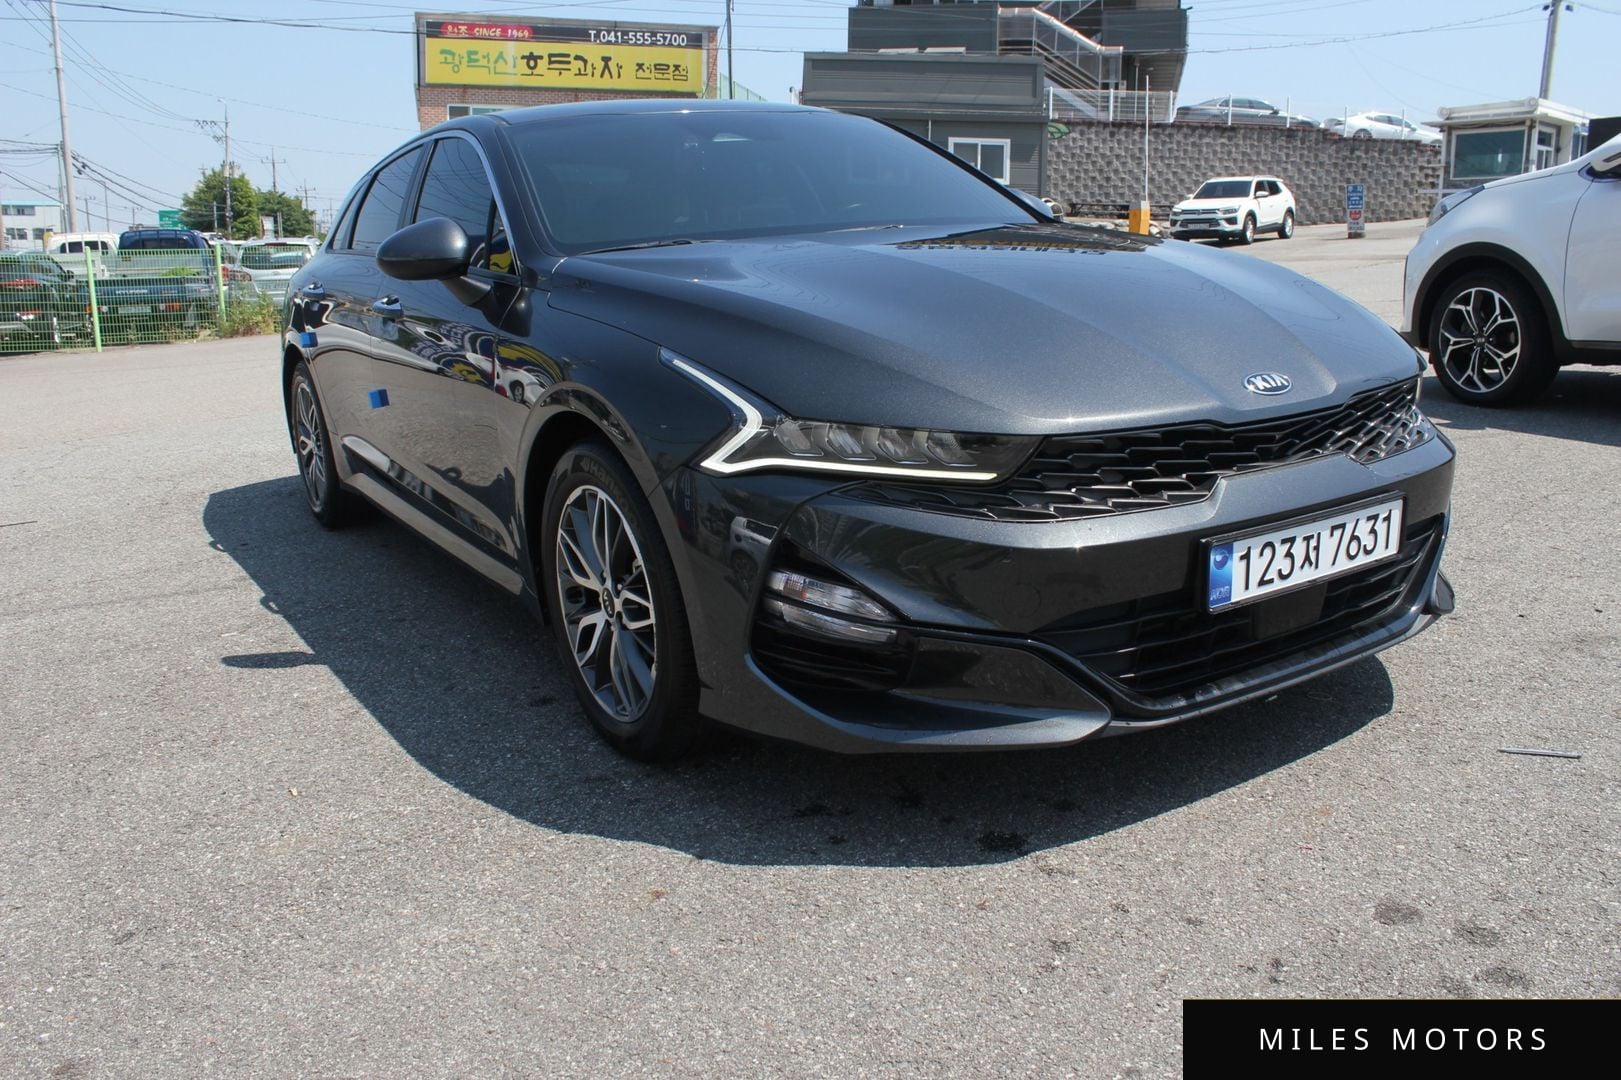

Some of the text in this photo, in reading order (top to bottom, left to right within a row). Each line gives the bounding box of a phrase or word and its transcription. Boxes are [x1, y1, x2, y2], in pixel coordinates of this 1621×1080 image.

[474, 27, 502, 37] SINCE
[507, 28, 529, 39] 1969
[588, 30, 687, 46] T.041-555-5700
[635, 62, 689, 81] 전문점
[1249, 373, 1290, 391] KIA
